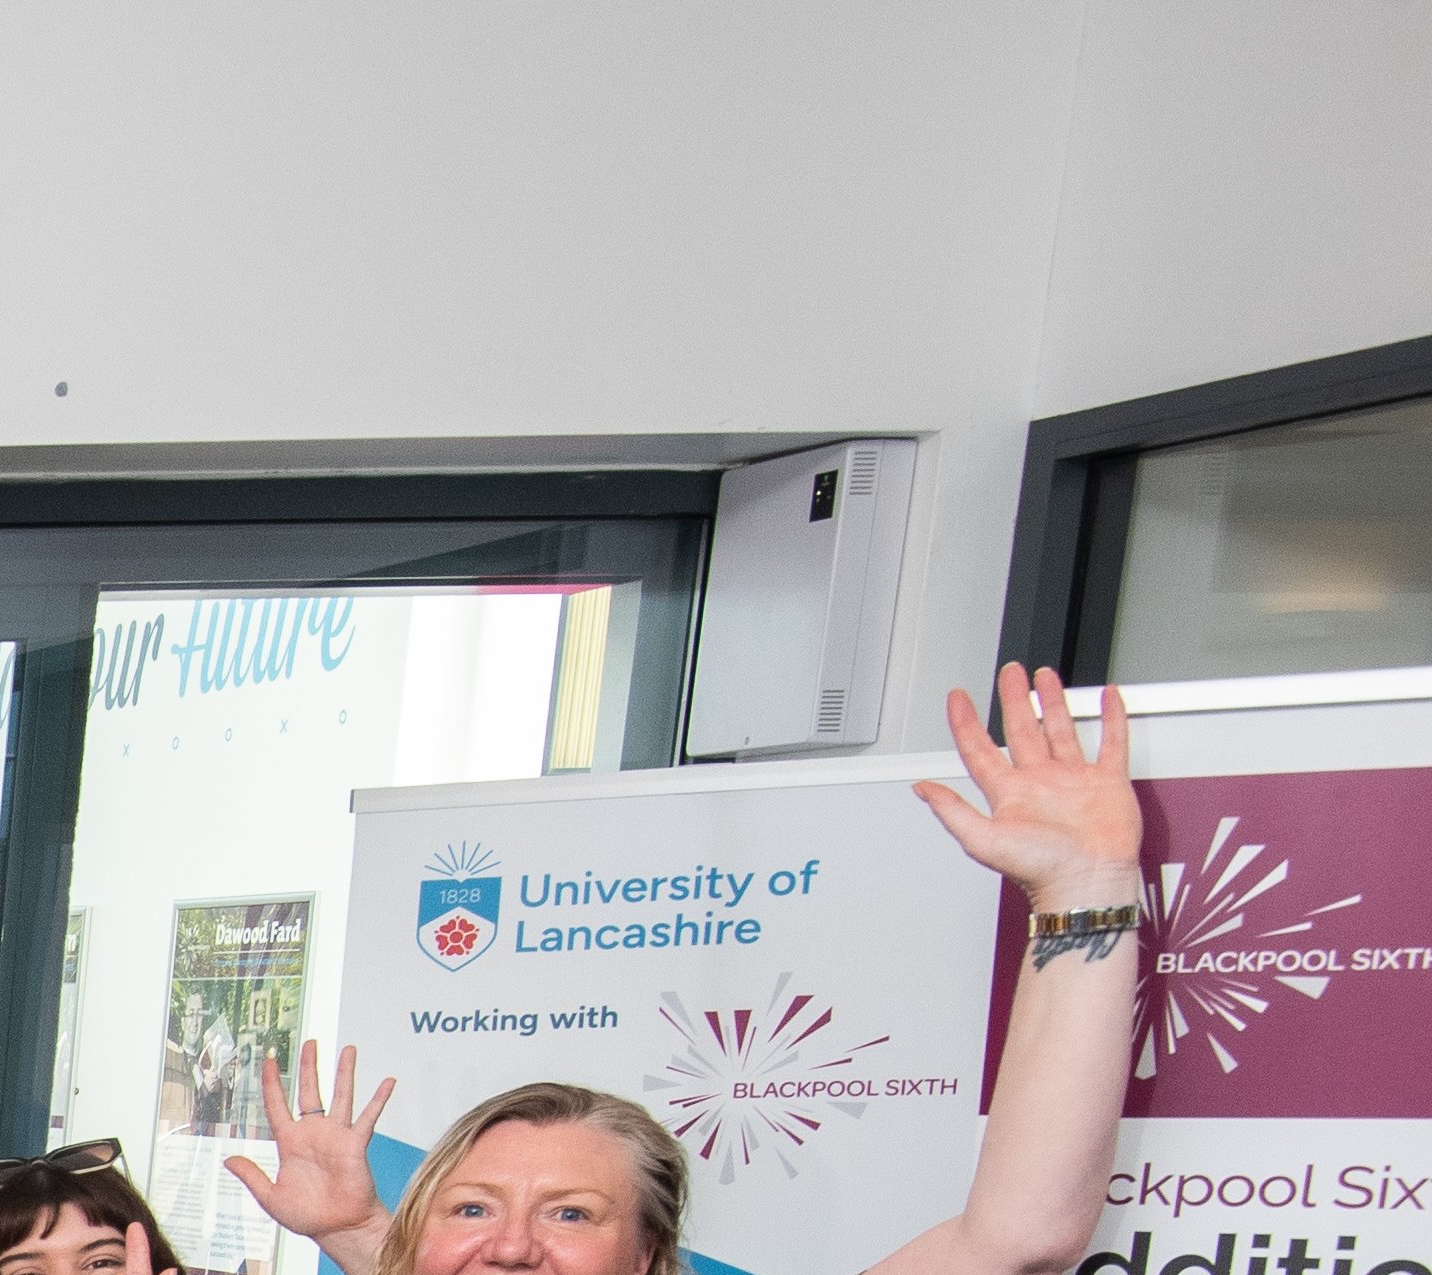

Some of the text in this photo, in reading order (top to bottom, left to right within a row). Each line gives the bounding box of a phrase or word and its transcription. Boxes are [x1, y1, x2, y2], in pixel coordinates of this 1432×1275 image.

[171, 597, 356, 698] Future
[439, 887, 481, 904] 1828
[520, 859, 821, 909] University of
[215, 919, 301, 945] Dawood Fard
[514, 911, 762, 953] Lancashire
[1155, 950, 1345, 974] BLACKPOOL
[410, 1006, 619, 1036] Working with
[732, 1078, 958, 1100] BLACKPOOL SIXTH
[1331, 1165, 1432, 1211] Six
